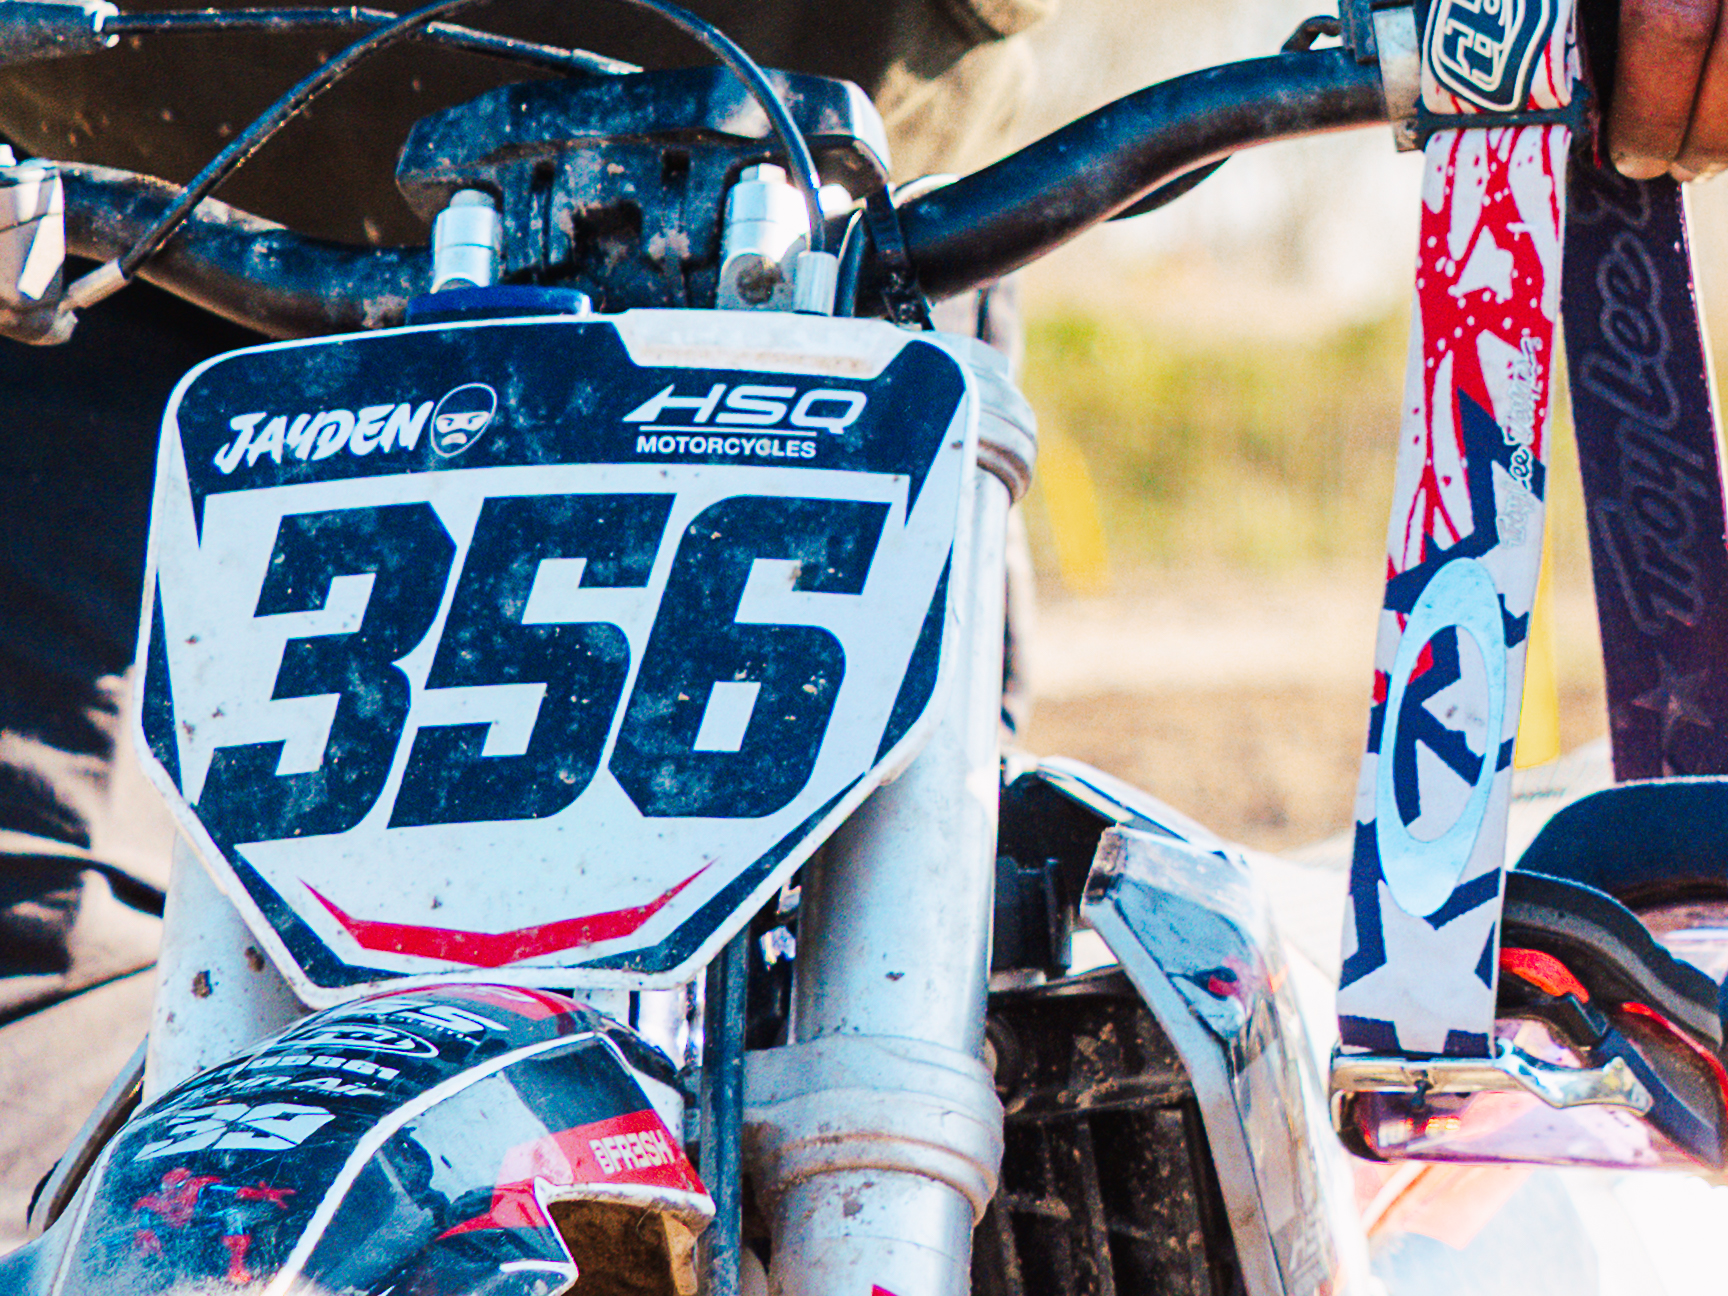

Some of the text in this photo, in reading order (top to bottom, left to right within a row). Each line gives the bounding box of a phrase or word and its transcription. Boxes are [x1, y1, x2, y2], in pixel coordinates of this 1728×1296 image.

[213, 401, 435, 475] JAYDEN
[623, 383, 867, 434] HSQ
[636, 435, 817, 459] MOTORCYCLES
[194, 491, 894, 845] 356
